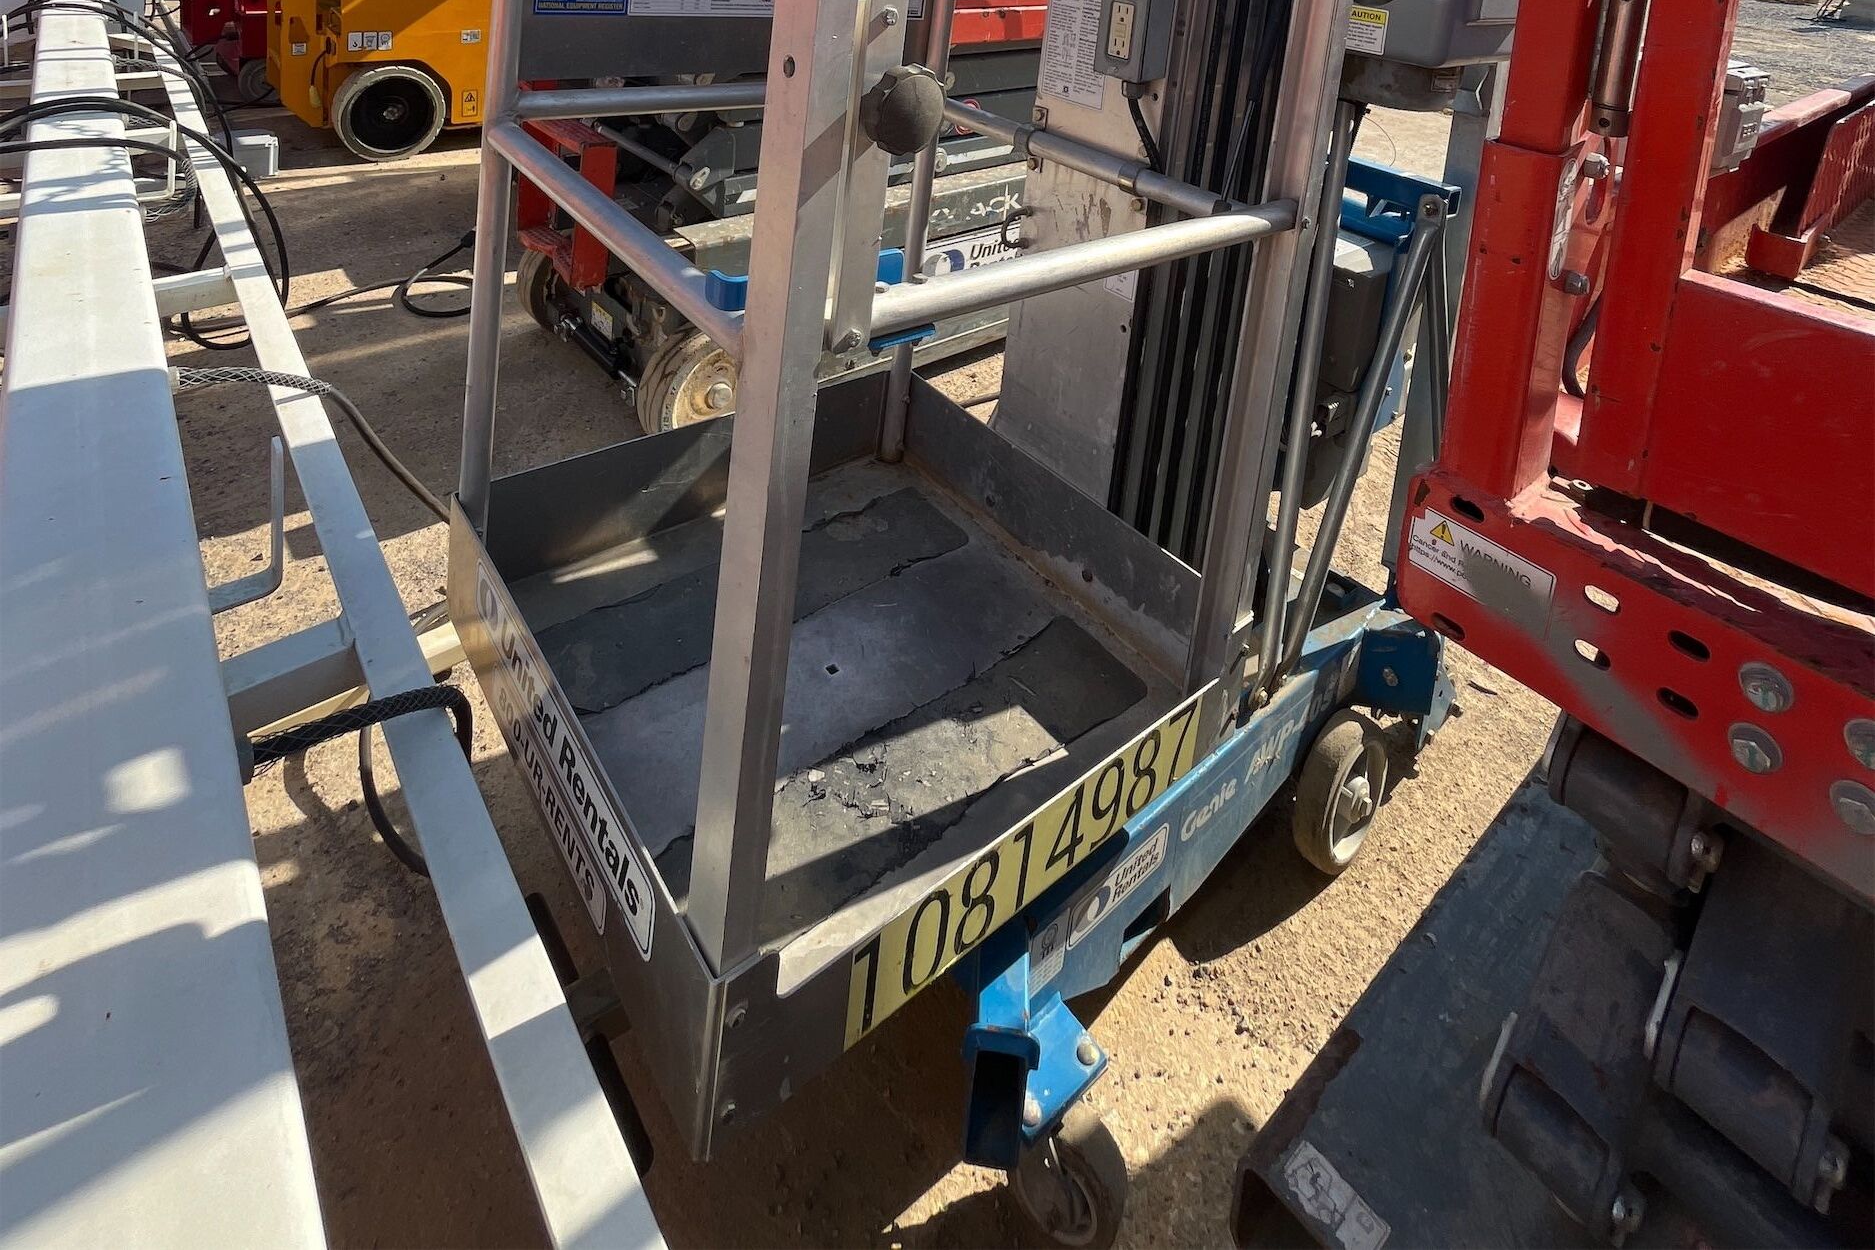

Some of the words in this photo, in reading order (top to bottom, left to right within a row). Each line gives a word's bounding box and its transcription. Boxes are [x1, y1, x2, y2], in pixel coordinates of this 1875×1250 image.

[1352, 10, 1382, 21] AUTION
[1412, 534, 1440, 554] Cancer
[502, 618, 558, 748] United
[558, 735, 641, 917] Rentals
[1180, 777, 1238, 842] Genie
[853, 701, 1199, 1033] 10814987
[1112, 852, 1160, 903] Rentals
[1115, 837, 1160, 887] United
